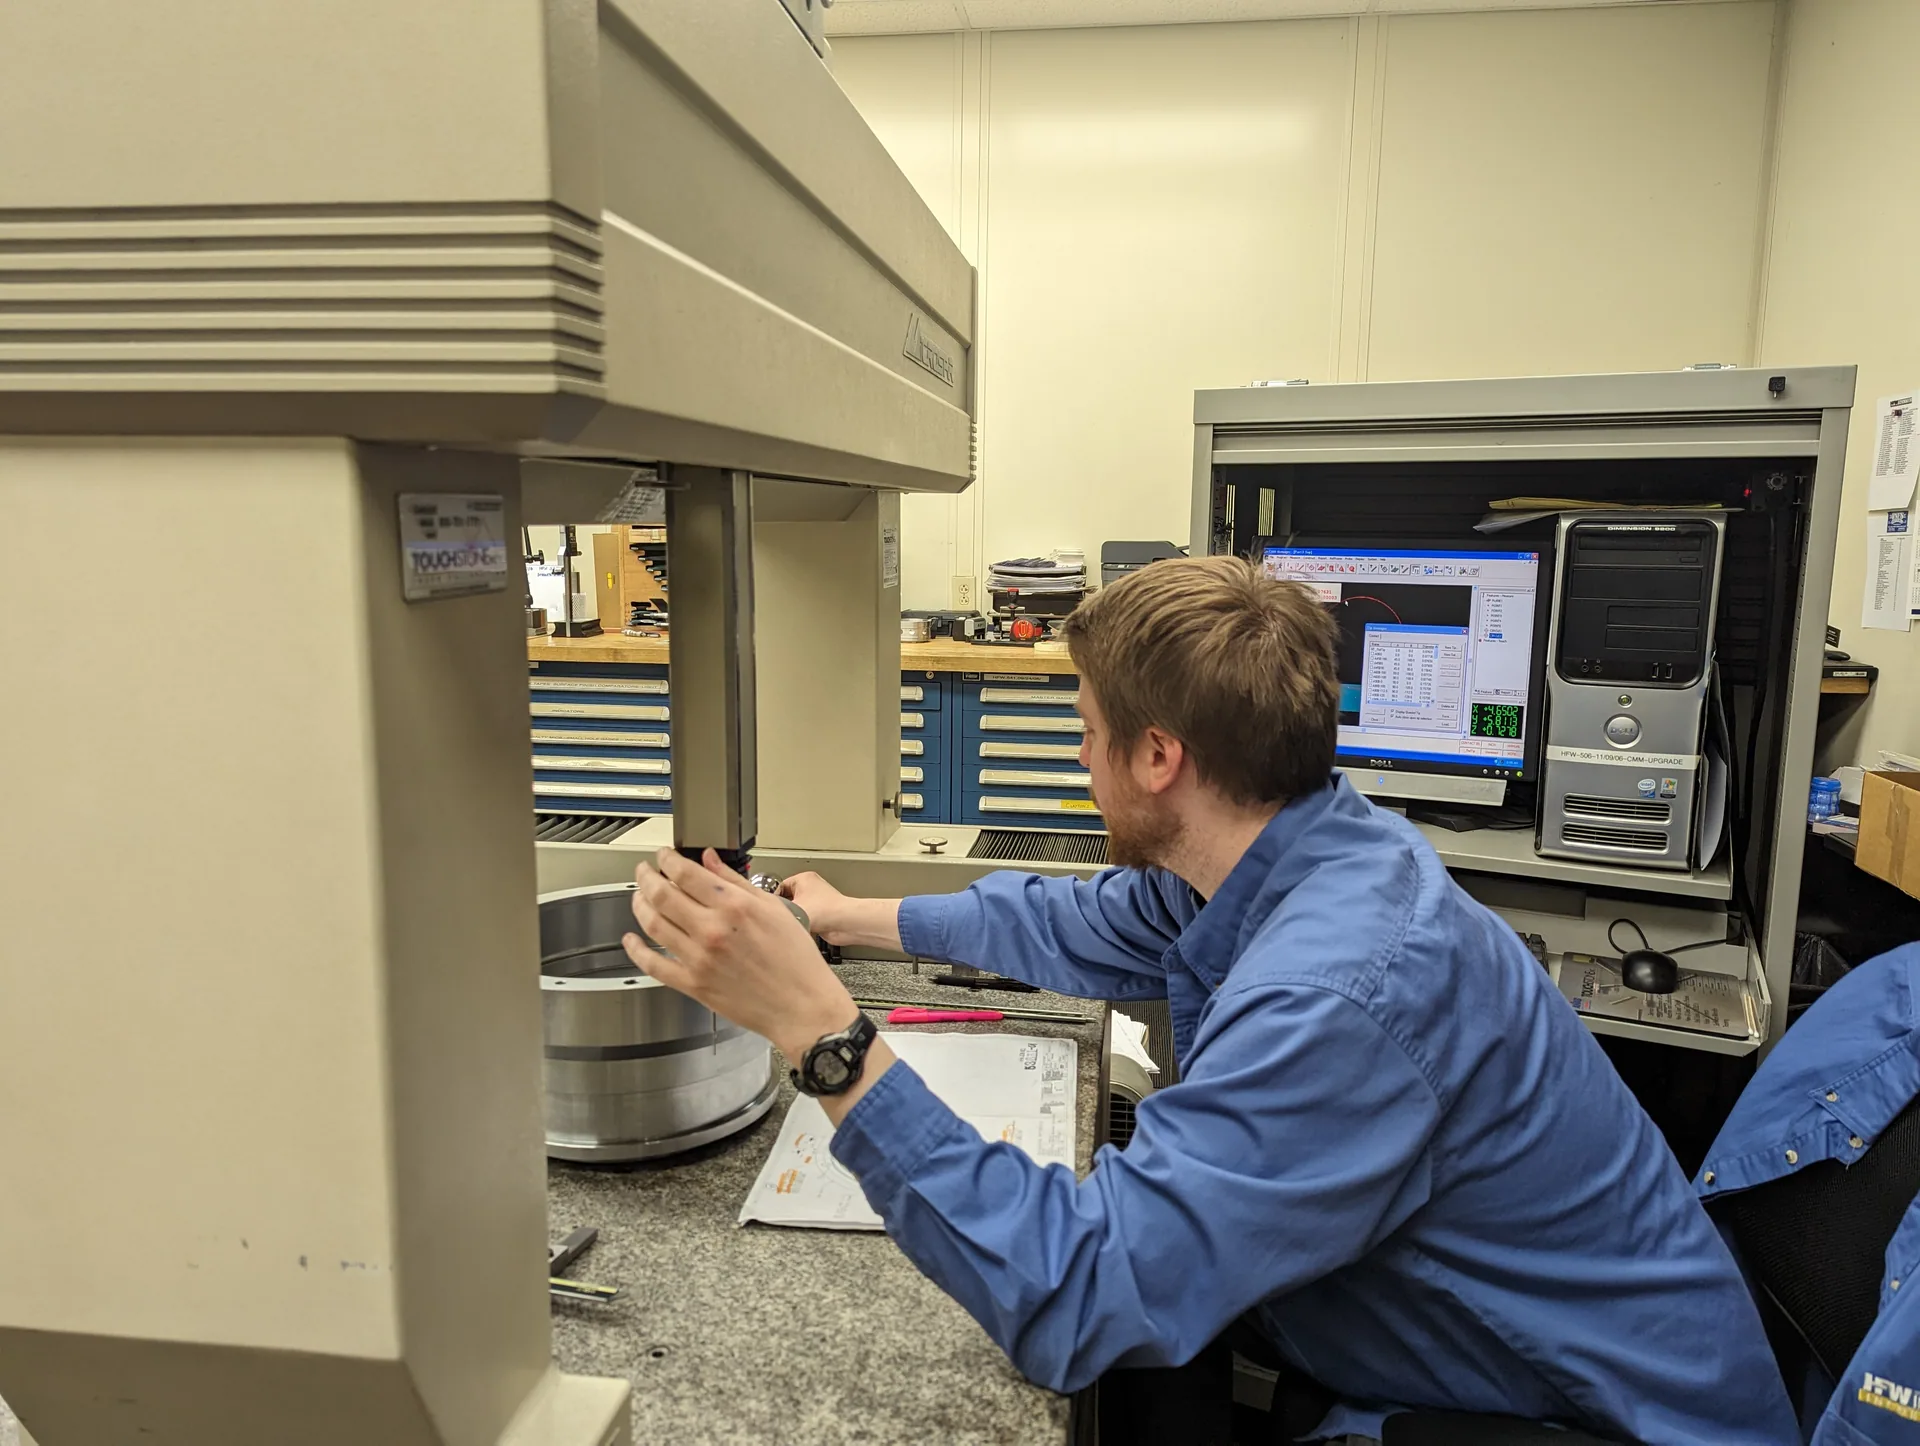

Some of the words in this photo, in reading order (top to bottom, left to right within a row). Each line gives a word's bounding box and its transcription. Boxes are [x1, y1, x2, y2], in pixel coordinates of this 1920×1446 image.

[411, 547, 491, 570] TOUCHSTOE
[1473, 705, 1478, 714] X
[1484, 706, 1518, 716] +4.6502
[1472, 725, 1477, 734] Z
[1610, 727, 1635, 735] DELL
[1370, 759, 1394, 768] DELL
[1863, 1372, 1912, 1406] HFW
